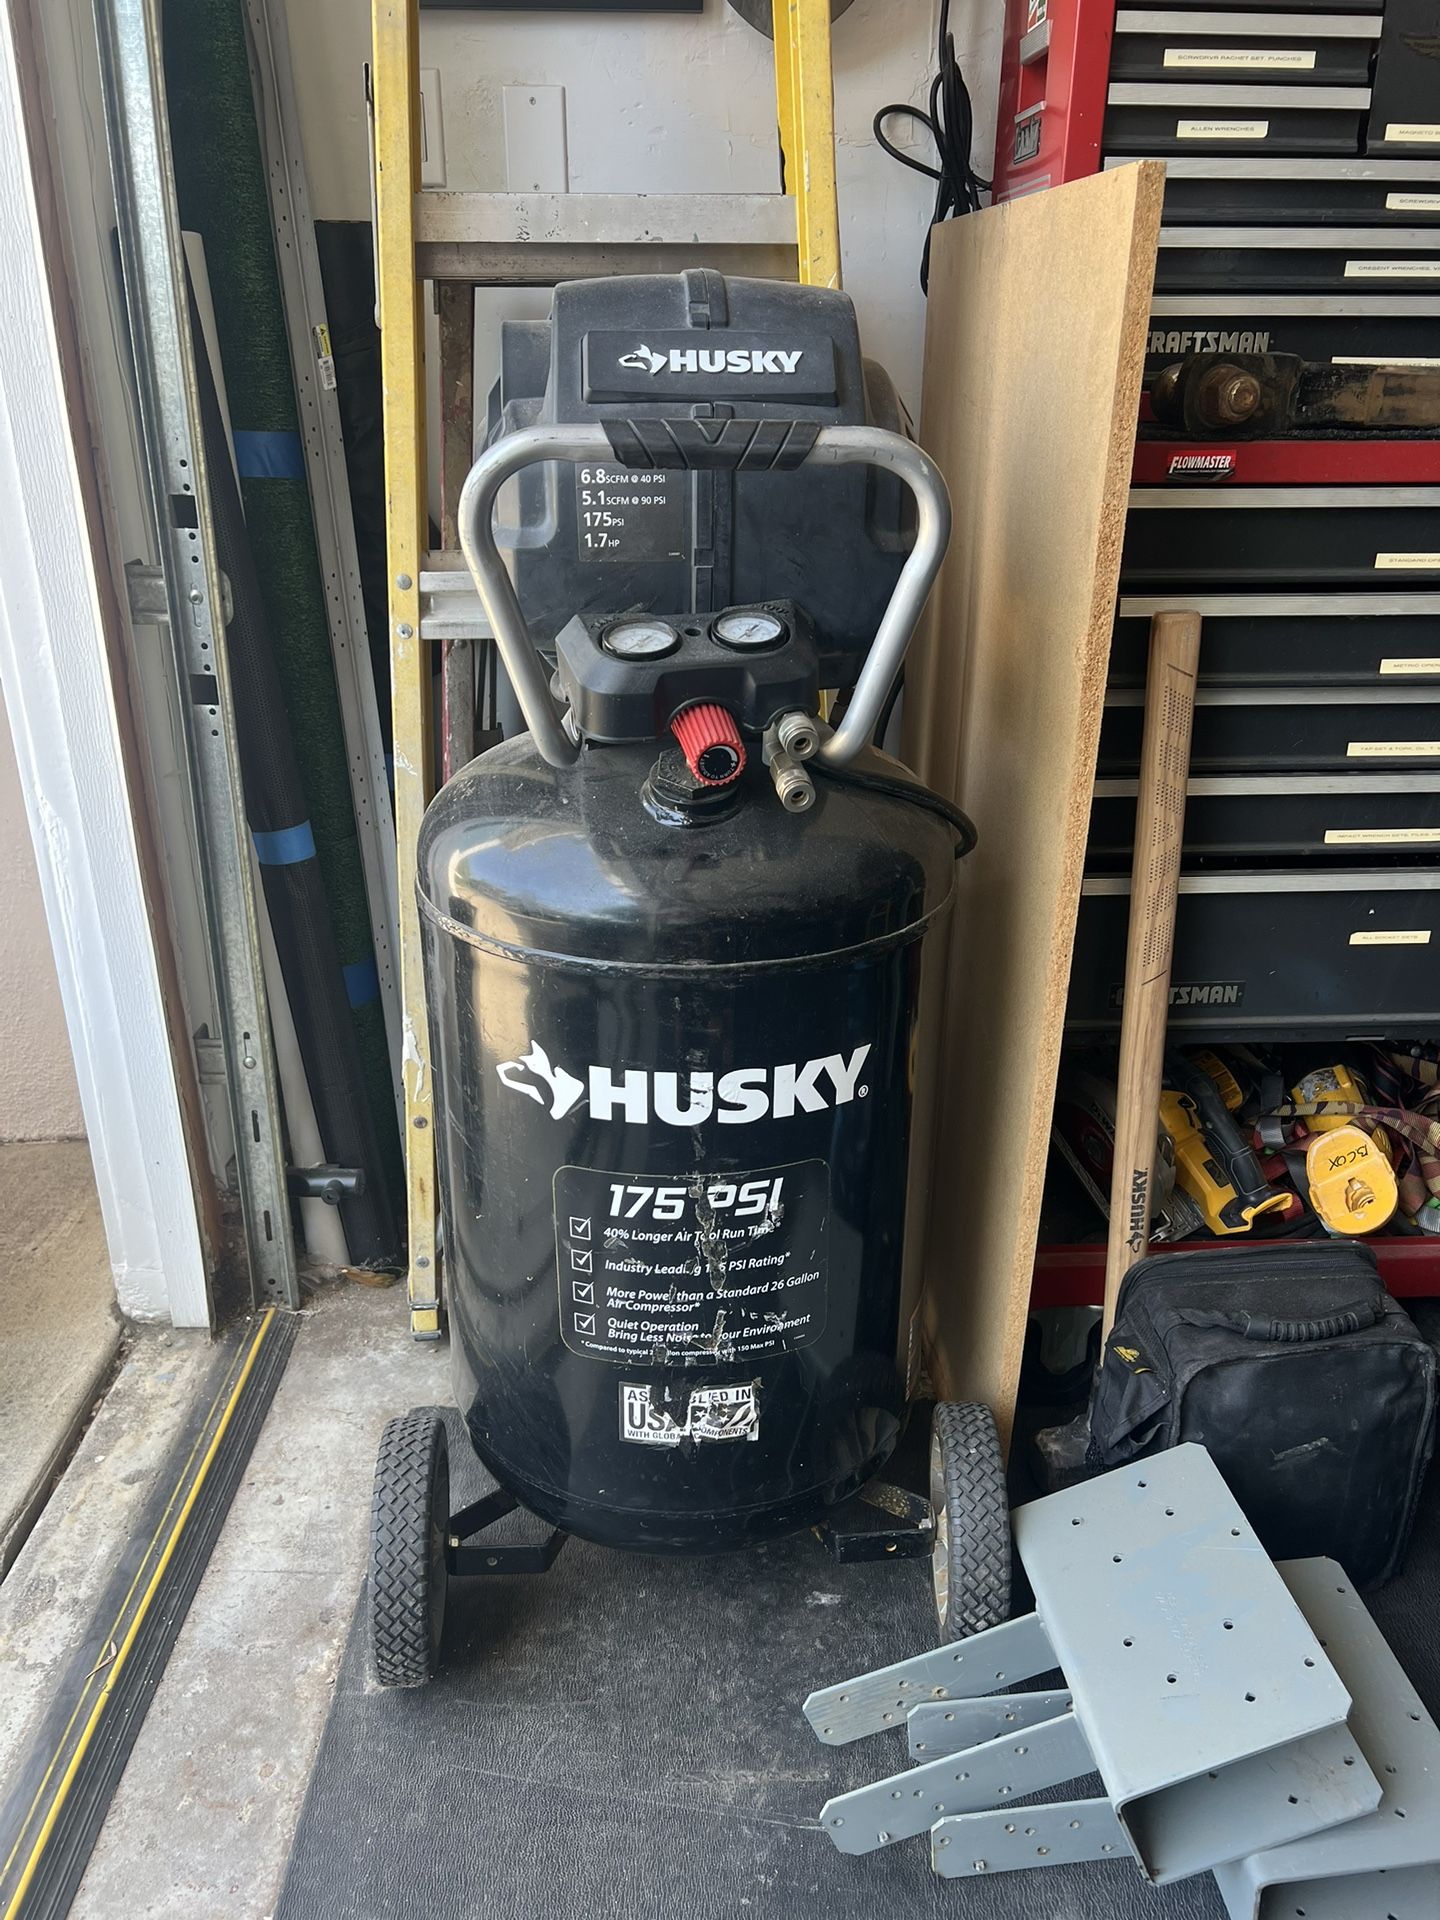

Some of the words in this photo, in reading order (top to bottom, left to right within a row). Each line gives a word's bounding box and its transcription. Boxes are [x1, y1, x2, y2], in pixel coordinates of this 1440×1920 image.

[669, 348, 803, 374] HUSKY
[1168, 456, 1232, 474] FLOWMASTER
[630, 475, 639, 484] @
[640, 474, 652, 483] 40
[653, 474, 666, 483] PSI
[631, 496, 640, 505] @
[641, 496, 652, 505] 90
[653, 496, 666, 505] PSI
[588, 1043, 872, 1126] HUSKY
[609, 1183, 687, 1220] 175
[1129, 1168, 1148, 1232] HUSKY
[603, 1227, 630, 1240] 40%
[631, 1229, 673, 1244] Longer
[674, 1229, 693, 1242] Air
[722, 1227, 745, 1240] Run
[604, 1259, 653, 1276] Industry
[654, 1263, 702, 1277] Leadig
[705, 1262, 727, 1275] 15
[728, 1258, 746, 1271] PSI
[606, 1286, 636, 1300] More
[637, 1289, 675, 1301] Powe
[676, 1290, 704, 1302] than
[706, 1292, 713, 1300] a
[716, 1284, 768, 1300] Standard
[769, 1280, 785, 1292] 26
[786, 1270, 820, 1288] Gallon
[606, 1297, 624, 1309] Air
[607, 1316, 638, 1331] Quiet
[640, 1320, 699, 1333] Operation
[607, 1328, 638, 1342] Bring
[640, 1331, 664, 1343] Less
[718, 1329, 740, 1341] our
[618, 1346, 625, 1354] to
[626, 1347, 649, 1358] typical
[737, 1344, 750, 1352] 150
[750, 1342, 764, 1350] Max
[764, 1339, 775, 1347] PSI
[735, 1387, 752, 1401] IN
[627, 1429, 650, 1439] WITH
